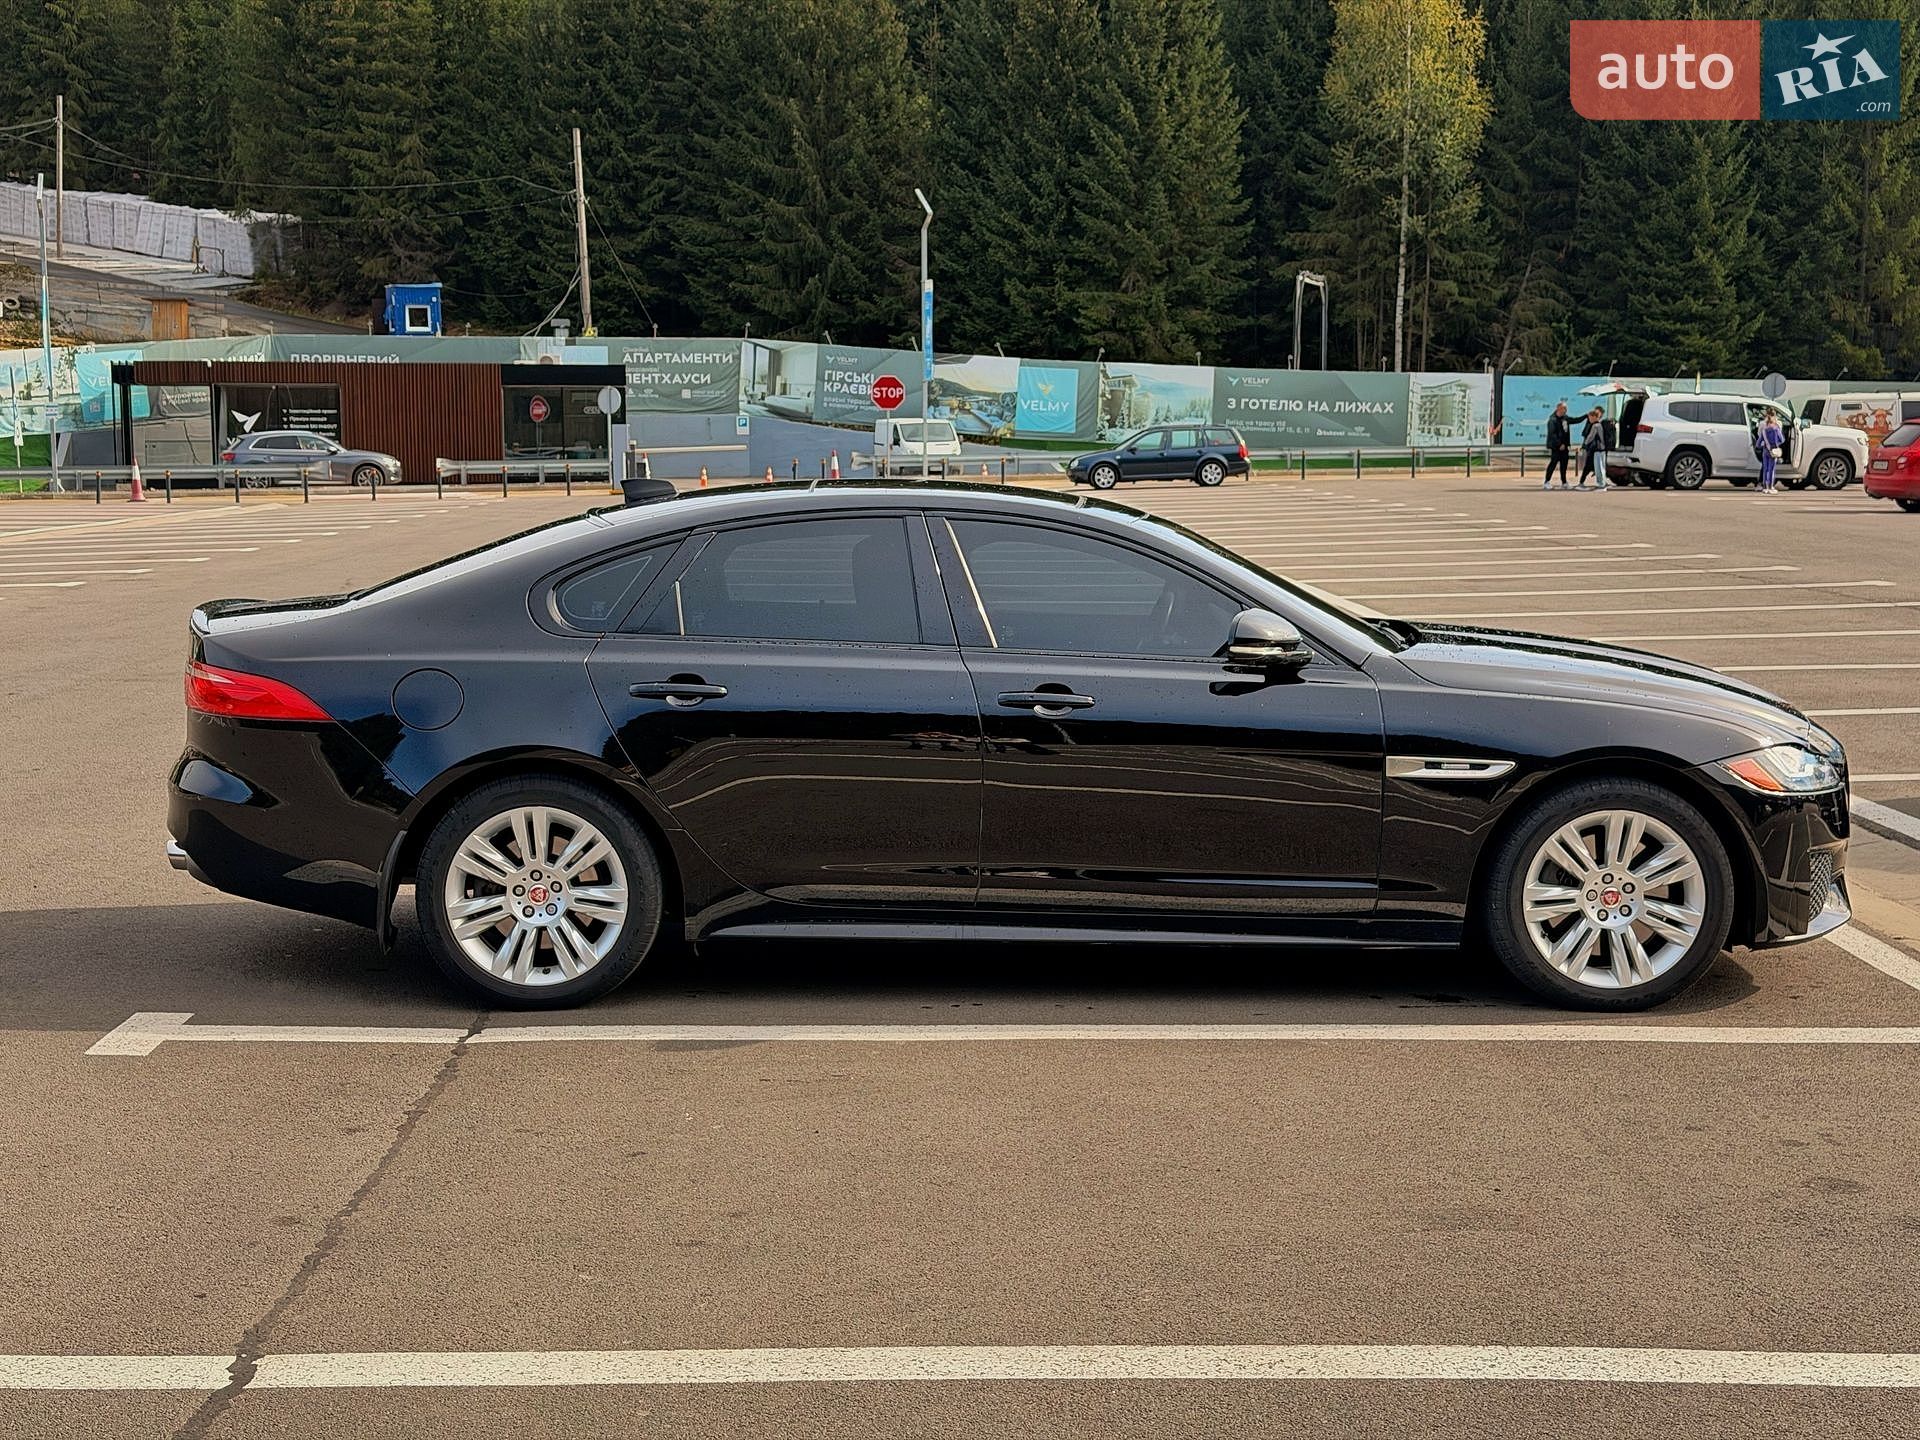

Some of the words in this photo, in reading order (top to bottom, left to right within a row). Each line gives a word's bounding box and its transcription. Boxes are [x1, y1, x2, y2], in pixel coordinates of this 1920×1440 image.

[623, 352, 733, 364] АПАРТАМЕНТИ
[824, 369, 875, 384] ГІРСЬКІ
[1242, 376, 1271, 385] VELMY
[873, 387, 903, 398] STOP
[1020, 398, 1070, 412] VELMY
[1240, 398, 1303, 411] ГОТЕЛЮ
[1307, 400, 1330, 412] НА
[1333, 401, 1394, 414] ЛИЖАХ
